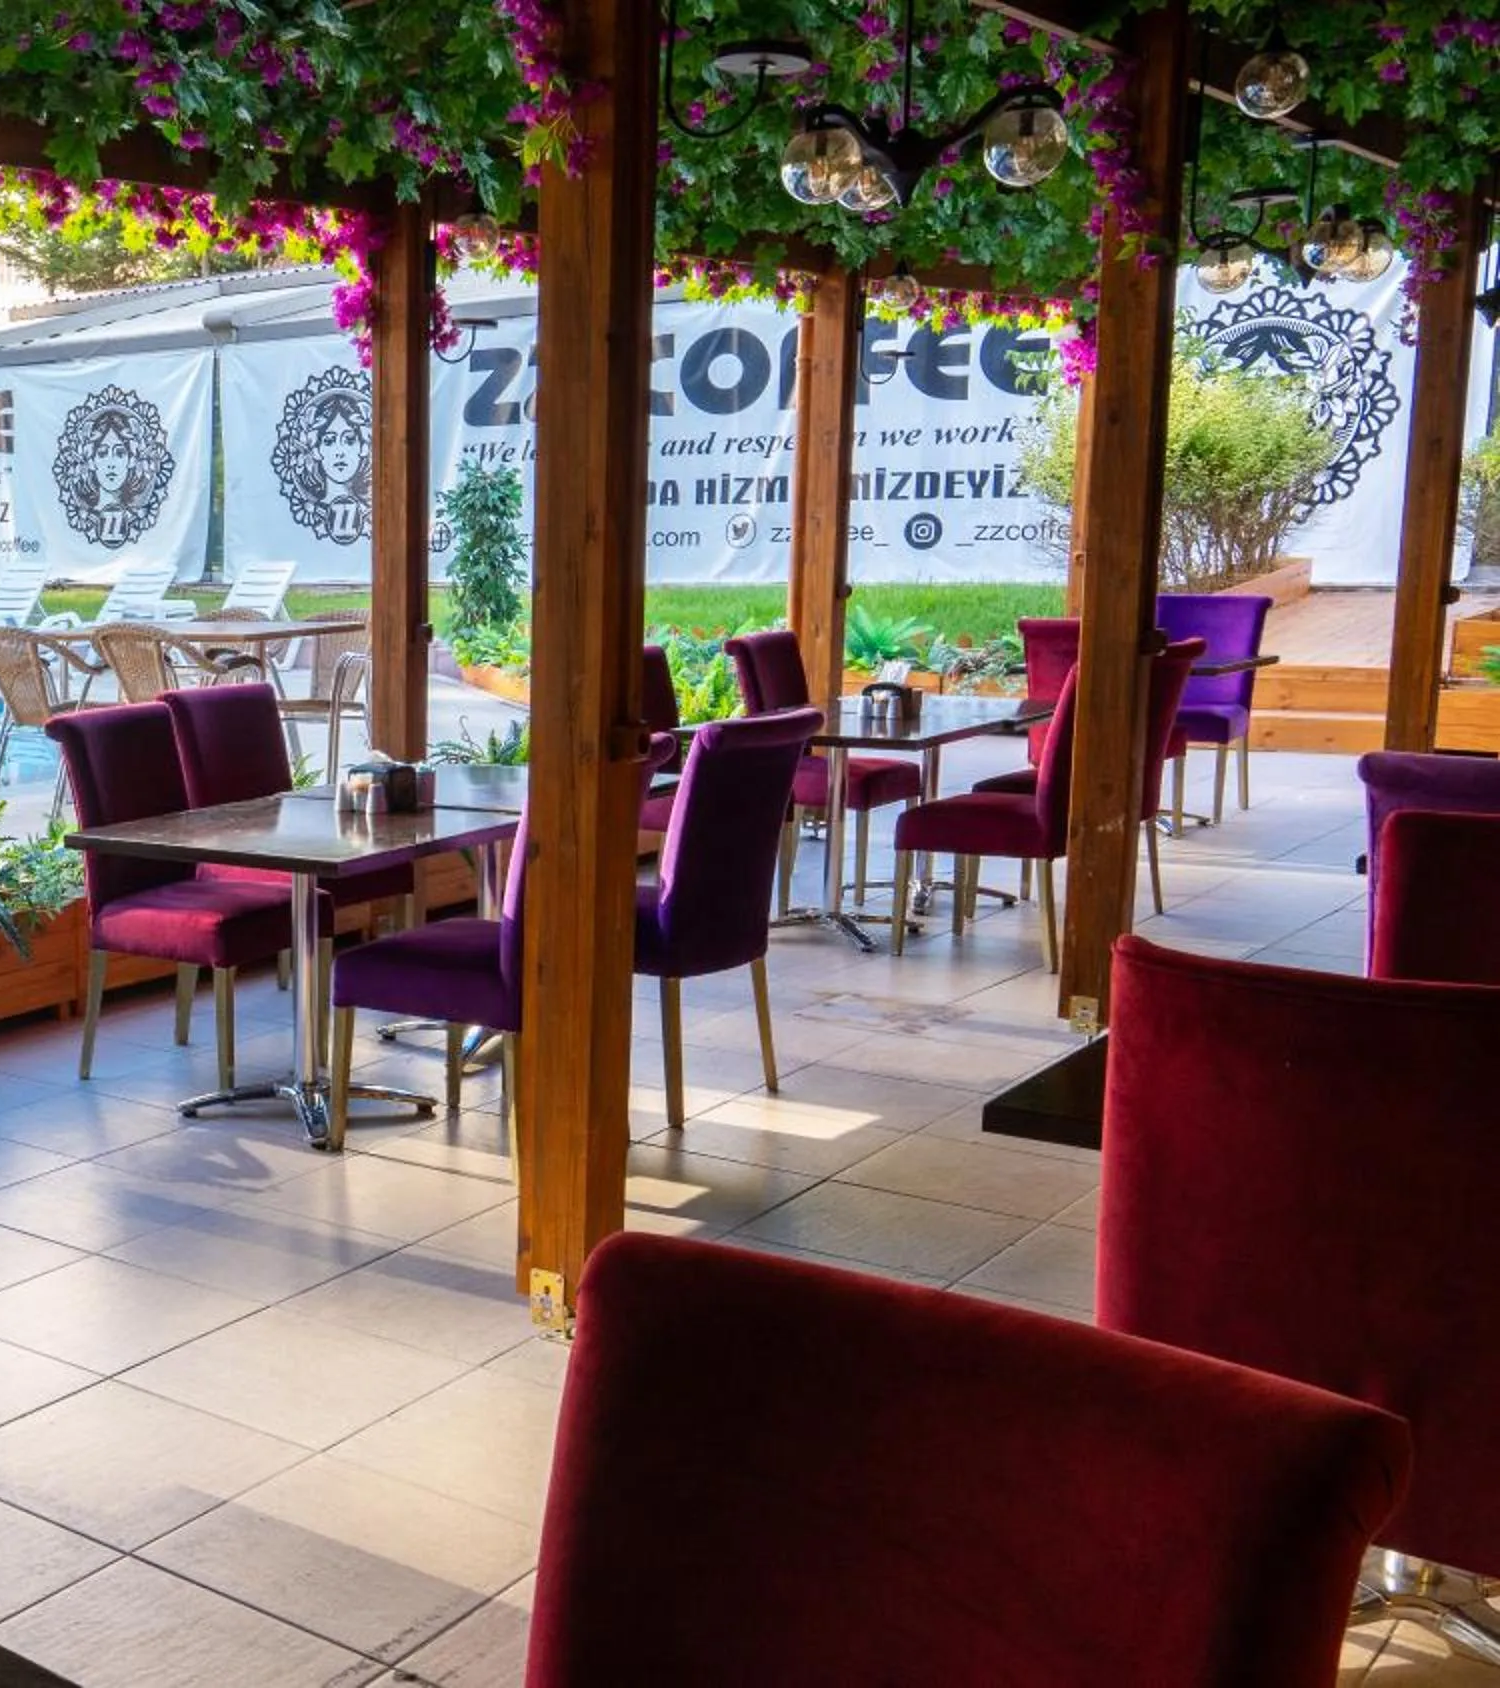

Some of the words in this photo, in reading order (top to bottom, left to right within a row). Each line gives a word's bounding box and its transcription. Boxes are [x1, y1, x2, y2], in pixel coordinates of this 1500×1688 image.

[661, 432, 717, 457] and
[723, 433, 797, 458] respe
[880, 427, 923, 447] we
[645, 530, 702, 547] .com
[954, 518, 1073, 547] _zzcoffe
